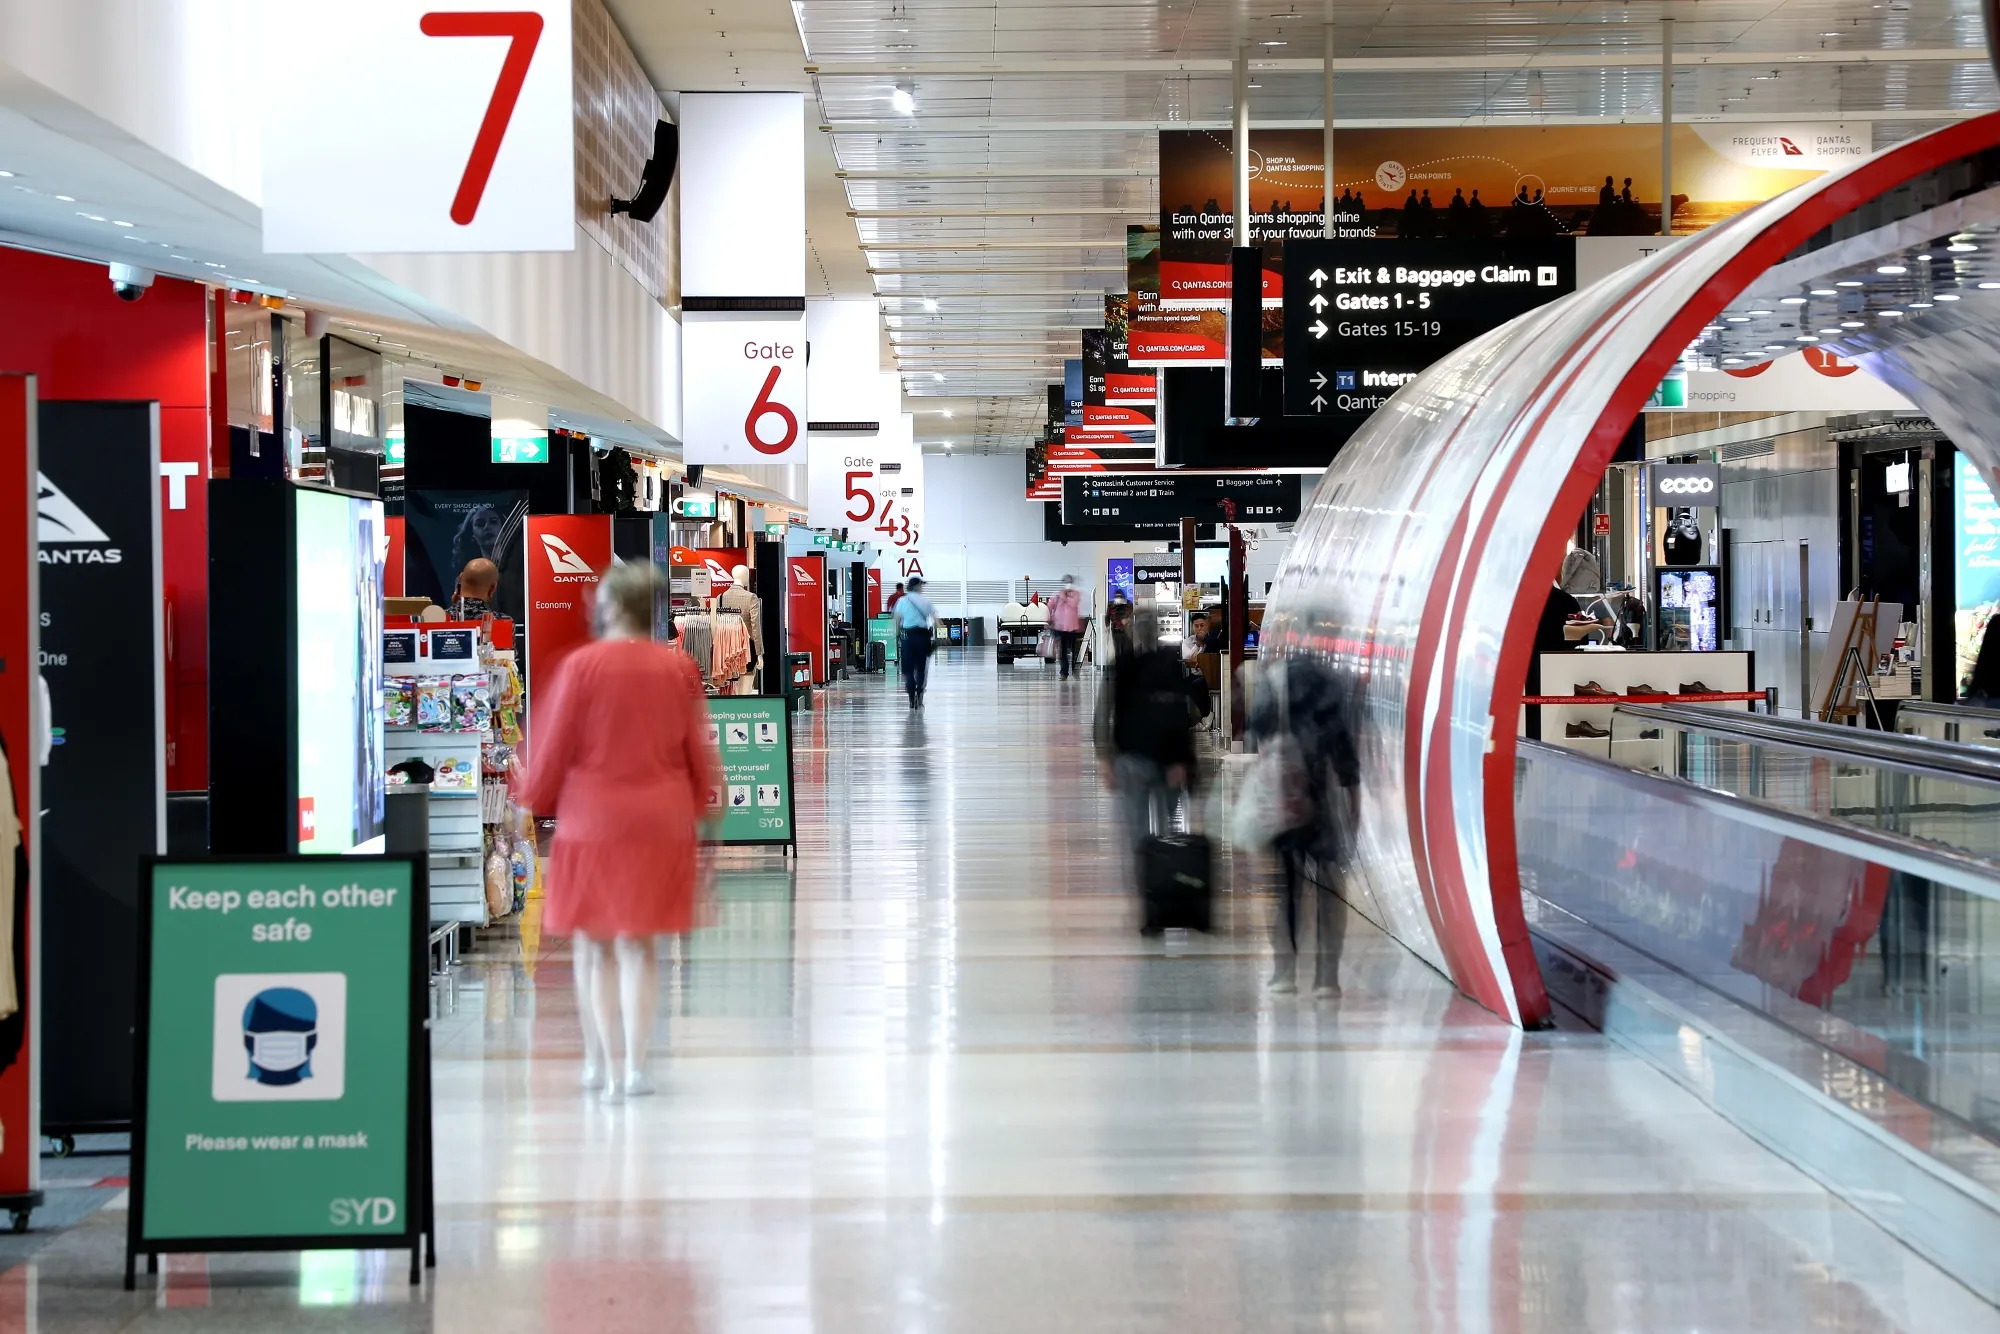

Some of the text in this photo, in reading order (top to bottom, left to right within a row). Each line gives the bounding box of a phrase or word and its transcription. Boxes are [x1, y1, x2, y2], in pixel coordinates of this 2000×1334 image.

[420, 12, 544, 225] 7
[1733, 137, 1778, 146] FREQUENT
[1817, 136, 1851, 145] QANTAS
[1751, 148, 1778, 156] FLYER
[1816, 146, 1861, 155] SHOPPING
[1172, 213, 1197, 225] Earn
[1248, 212, 1274, 224] oints
[1276, 212, 1325, 228] shopping
[1172, 227, 1196, 240] with
[1200, 229, 1220, 240] over
[1249, 227, 1260, 239] of
[1262, 229, 1286, 241] your
[1335, 266, 1531, 287] Exit & Baggage Claim
[1138, 290, 1158, 300] Earn
[1336, 294, 1389, 310] Gates
[1394, 293, 1402, 309] 1
[1419, 292, 1431, 309] 5
[1138, 303, 1156, 312] with
[1164, 315, 1180, 323] spend
[1338, 322, 1441, 336] Gates 15-19
[744, 341, 794, 360] Gate
[1338, 376, 1354, 386] T1
[1688, 390, 1736, 402] shopping
[744, 365, 798, 455] 6
[844, 456, 874, 468] Gate
[1226, 479, 1254, 487] Baggage
[1660, 477, 1714, 494] ecco
[845, 471, 876, 522] 5
[880, 488, 898, 498] ate
[875, 500, 899, 538] 4
[898, 558, 924, 578] 1A
[1148, 570, 1178, 580] sunglass
[536, 600, 572, 611] Economy
[737, 712, 752, 720] you
[738, 764, 770, 772] yourself
[730, 774, 756, 782] others
[759, 818, 784, 828] SYD
[169, 883, 397, 914] Keep each other
[252, 918, 312, 942] safe
[185, 1131, 369, 1151] Please wear a mask
[329, 1196, 397, 1226] SYD
